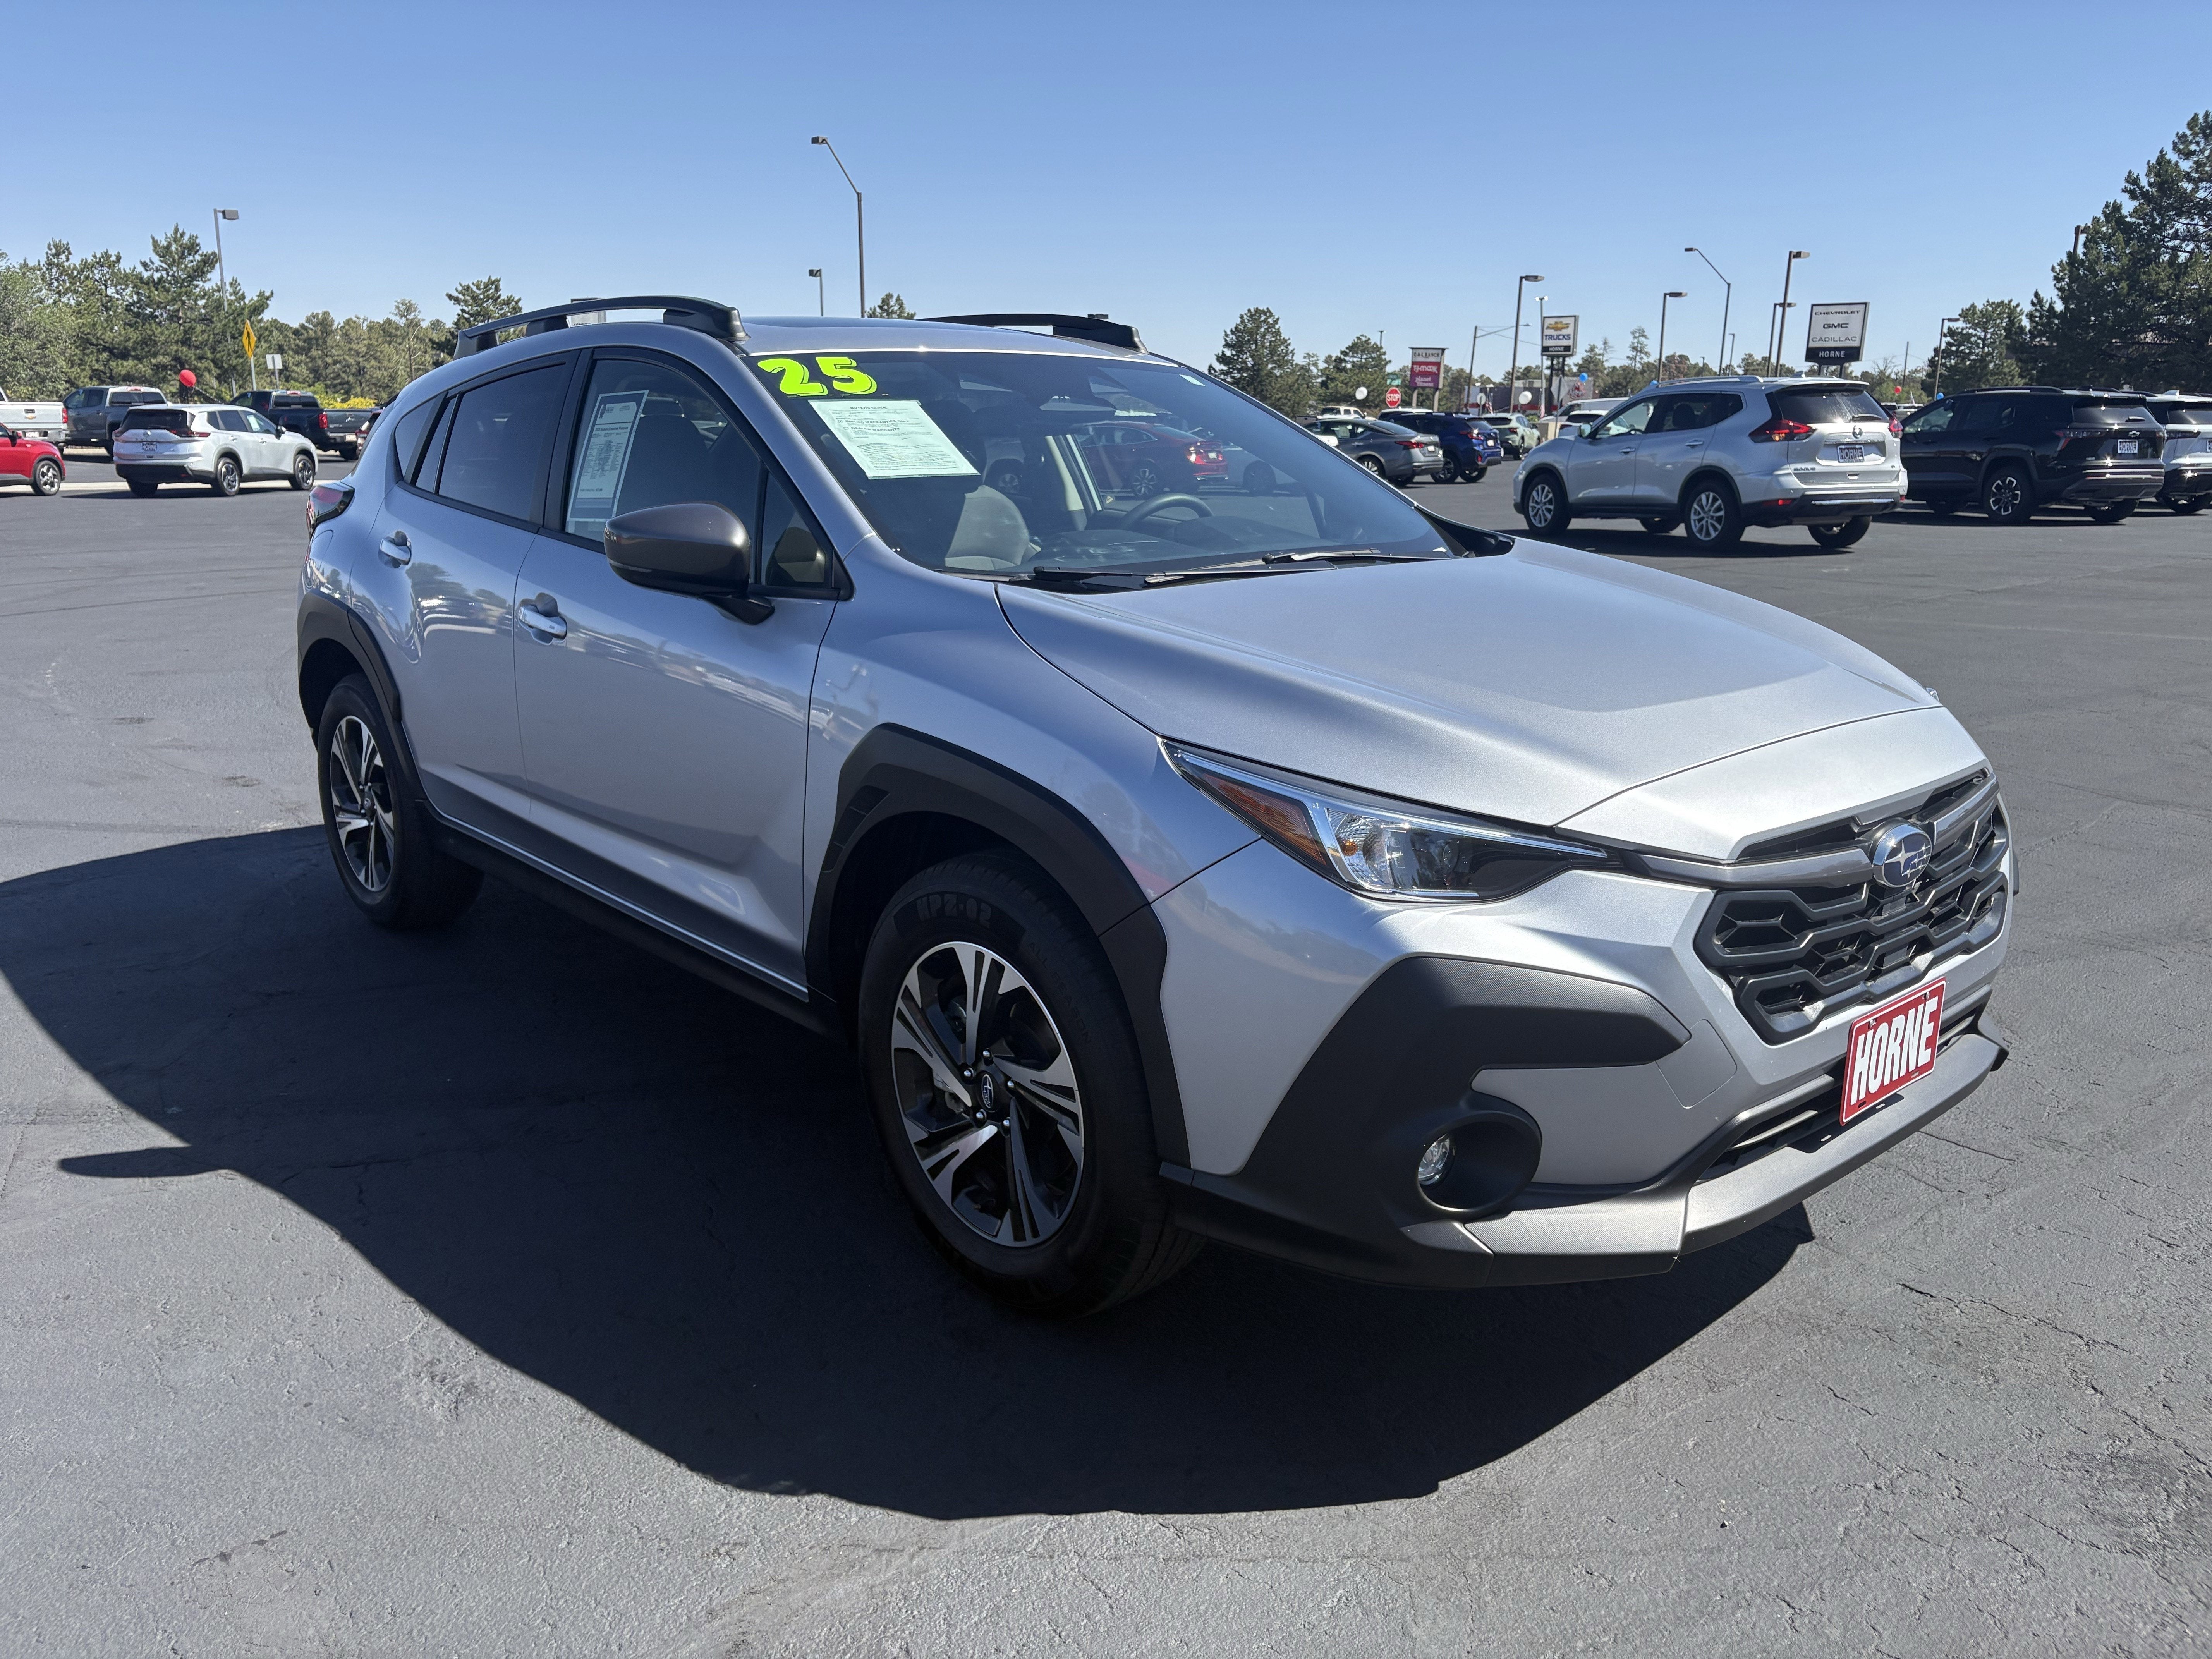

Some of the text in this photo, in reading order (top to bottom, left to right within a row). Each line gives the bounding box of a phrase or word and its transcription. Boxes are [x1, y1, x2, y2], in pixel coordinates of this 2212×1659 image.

[757, 357, 877, 396] 25
[1386, 393, 1400, 402] STOP
[2119, 442, 2136, 450] HORNE
[1840, 449, 1863, 460] HORNE
[1850, 996, 1939, 1106] HORNE
